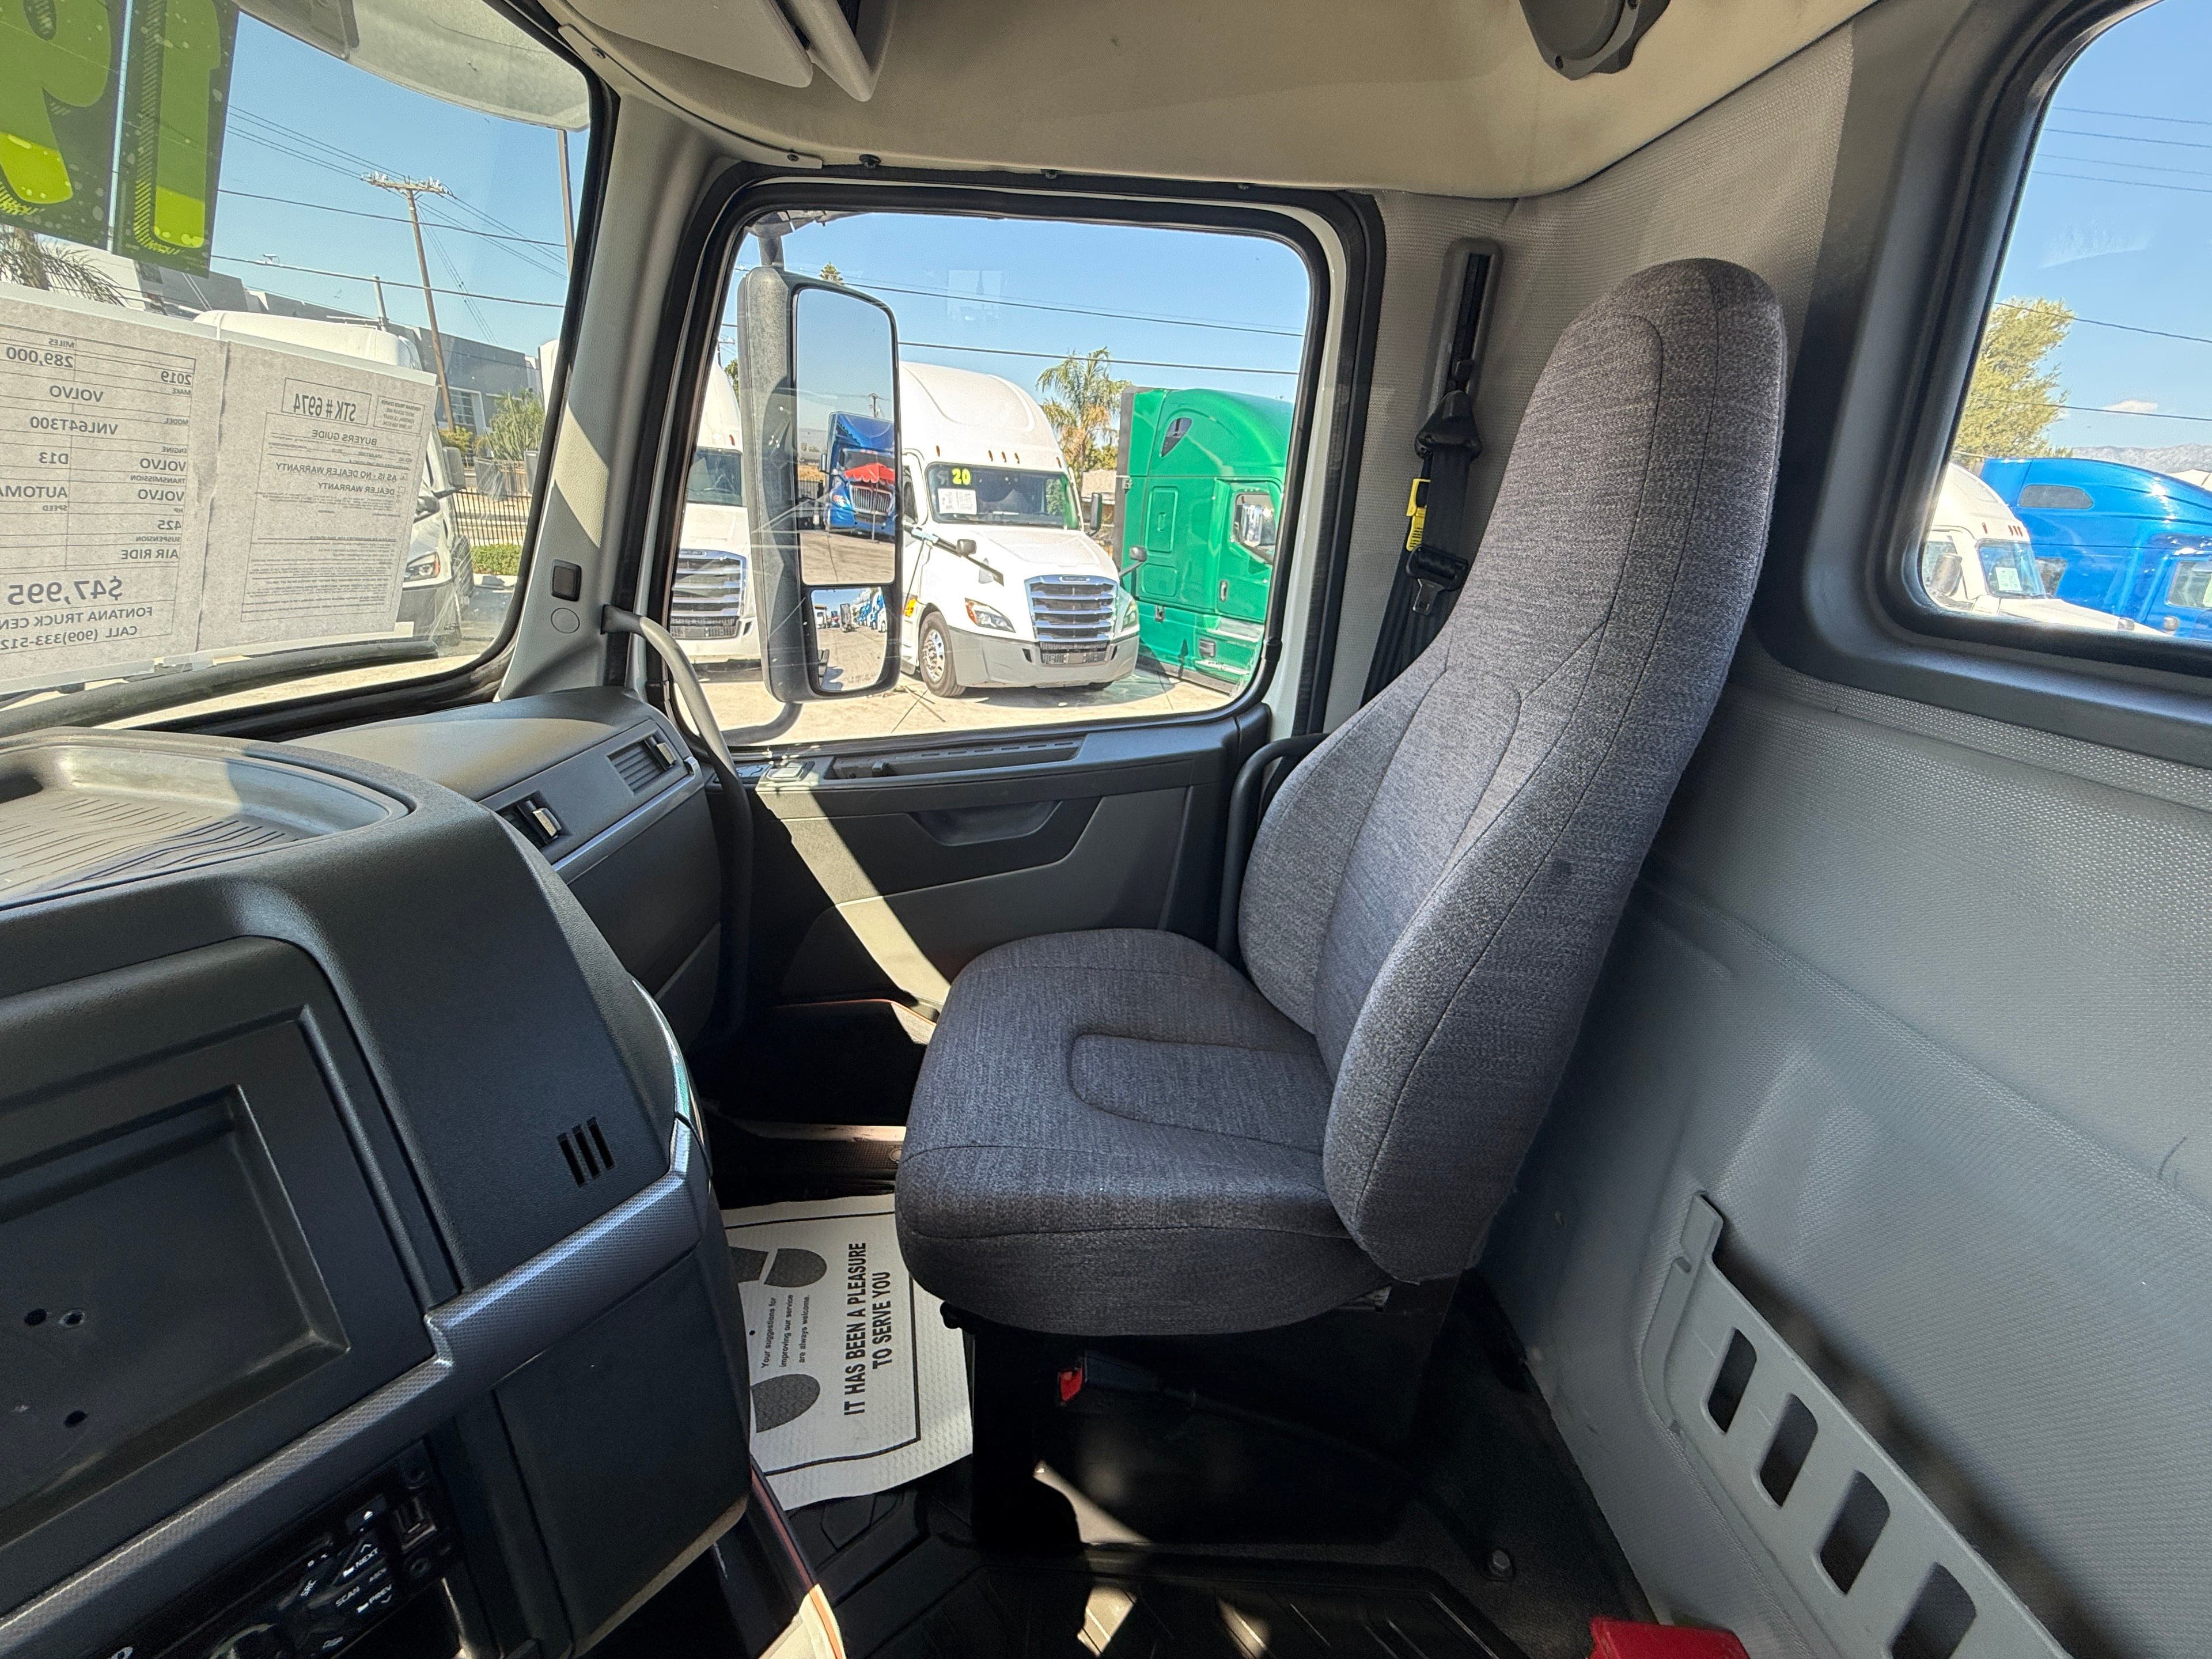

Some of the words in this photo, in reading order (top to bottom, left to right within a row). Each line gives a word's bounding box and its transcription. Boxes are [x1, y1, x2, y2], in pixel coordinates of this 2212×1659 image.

[952, 468, 971, 486] 20
[847, 1243, 866, 1305] PLEASURE
[872, 1272, 891, 1298] YOU
[768, 1297, 777, 1306] for
[801, 1295, 810, 1324] welcome.
[847, 1308, 865, 1317] A
[872, 1301, 892, 1344] SERVE
[765, 1308, 775, 1349] suggestions
[799, 1327, 809, 1349] always
[846, 1323, 865, 1359] BEEN
[761, 1351, 770, 1369] Your
[872, 1348, 892, 1369] TO
[844, 1364, 865, 1395] HAS
[844, 1401, 865, 1415] IT
[355, 1548, 378, 1567] NEXT
[335, 1586, 360, 1607] SCAN
